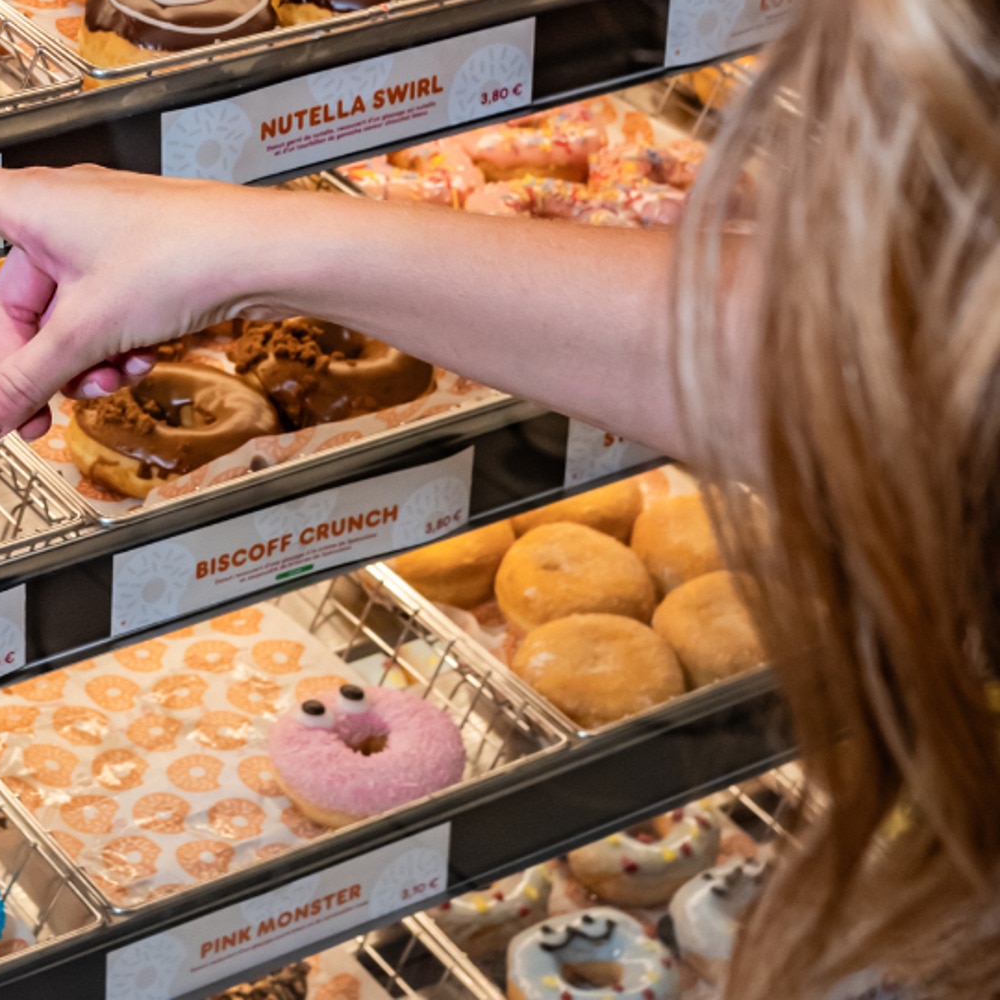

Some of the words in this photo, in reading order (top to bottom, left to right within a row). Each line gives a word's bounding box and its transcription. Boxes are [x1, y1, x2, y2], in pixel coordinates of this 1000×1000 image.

[260, 95, 365, 141] NUTELLA
[373, 75, 443, 110] SWIRL
[480, 87, 508, 106] 3,80
[511, 83, 523, 97] €
[195, 533, 294, 580] BISCOFF
[299, 504, 398, 546] CRUNCH
[2, 651, 16, 665] €
[200, 926, 251, 959] PINK
[257, 884, 363, 935] MONSTER
